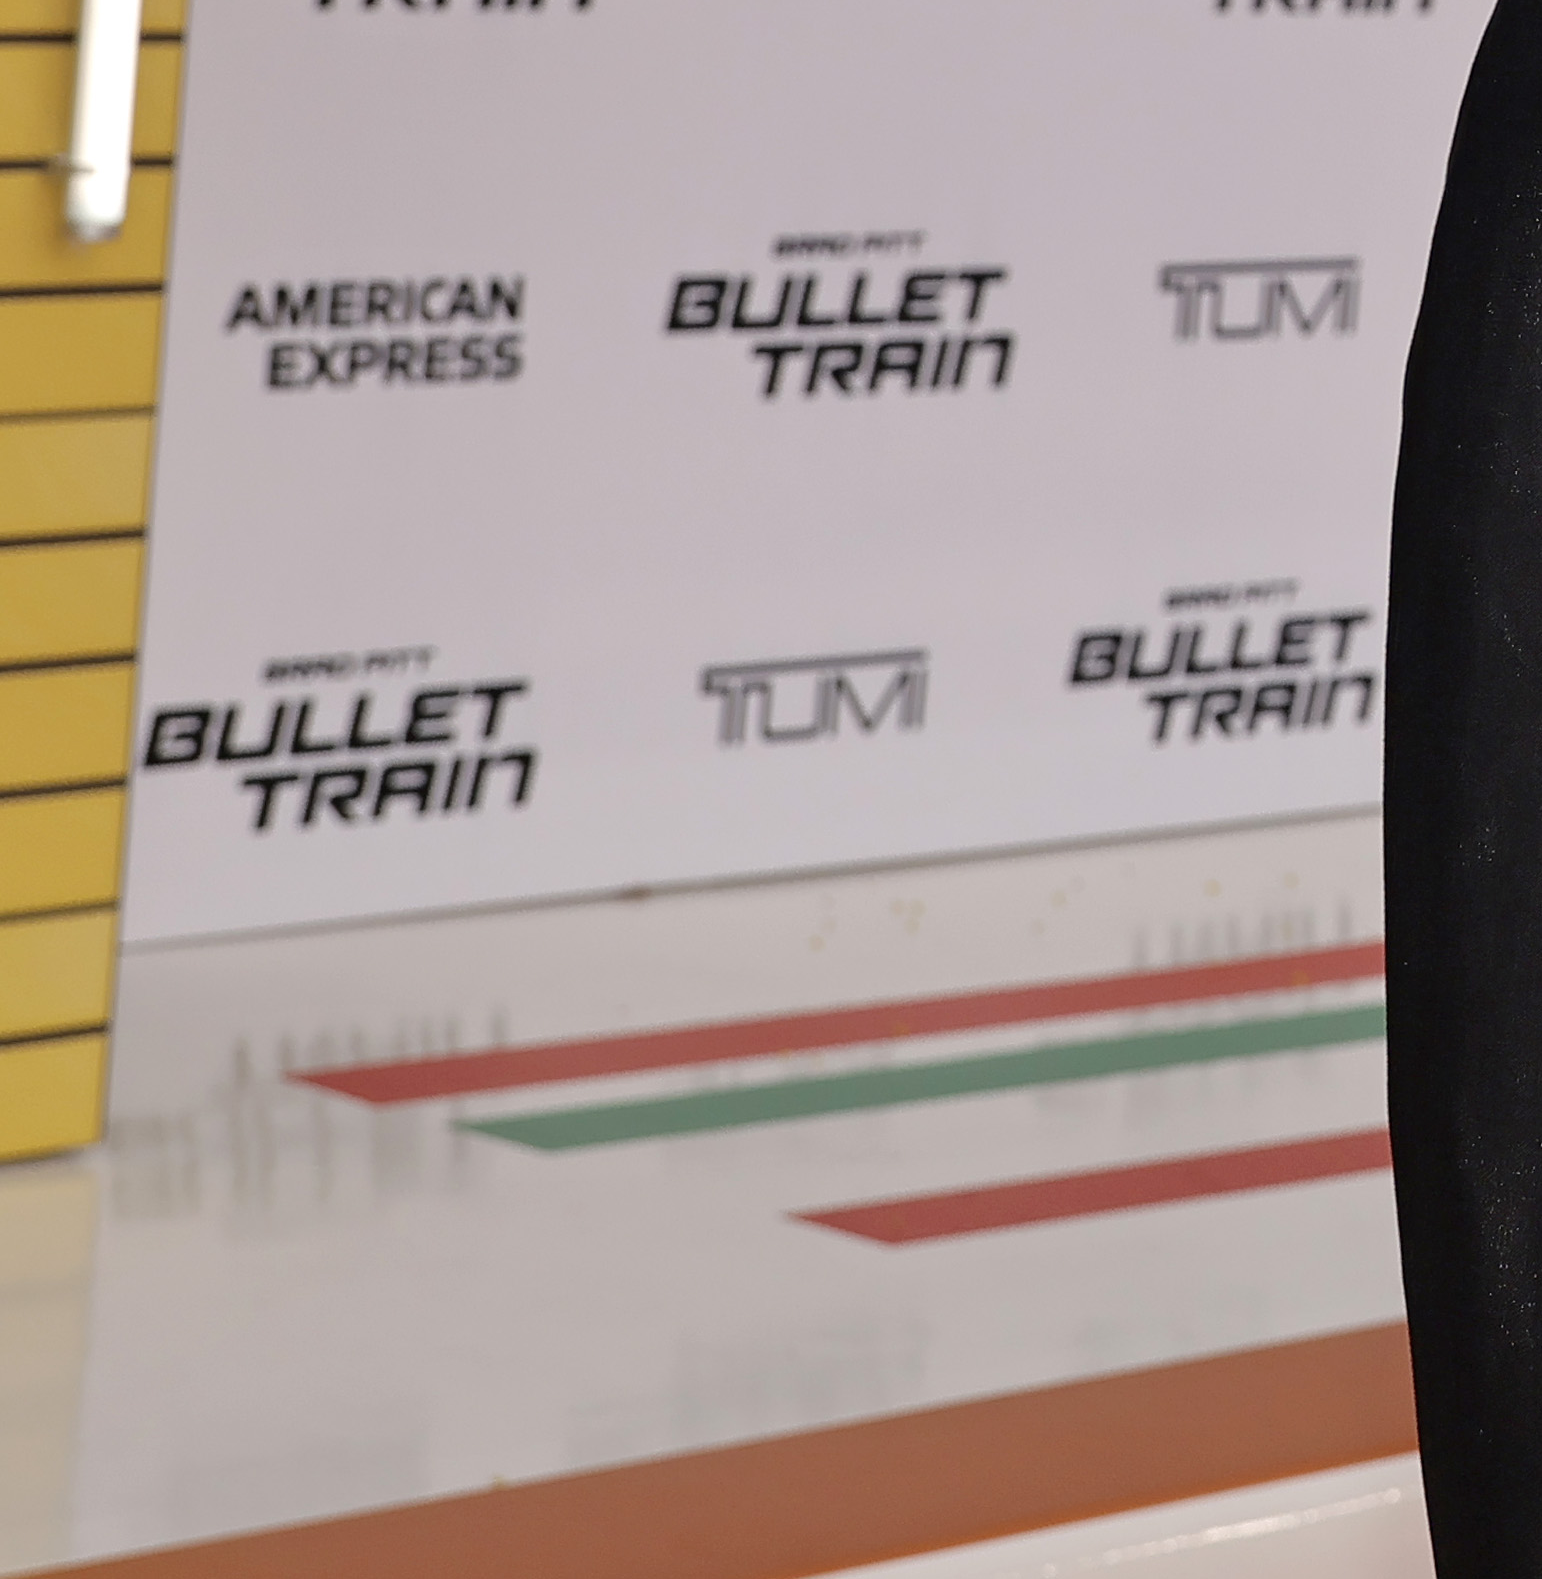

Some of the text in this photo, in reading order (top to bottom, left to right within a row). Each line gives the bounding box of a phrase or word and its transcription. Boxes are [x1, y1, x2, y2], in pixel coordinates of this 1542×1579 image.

[226, 277, 523, 331] AMERICAN
[665, 268, 1007, 334] BULLET
[1156, 255, 1361, 343] TUMI
[265, 333, 523, 391] EXPRESS
[752, 333, 1014, 399] TRAIN
[1068, 611, 1370, 687] BULLET
[142, 681, 527, 771] BULLET
[697, 647, 930, 747] TUMI
[1145, 671, 1376, 743] TRAIN
[241, 749, 536, 831] TRAIN
